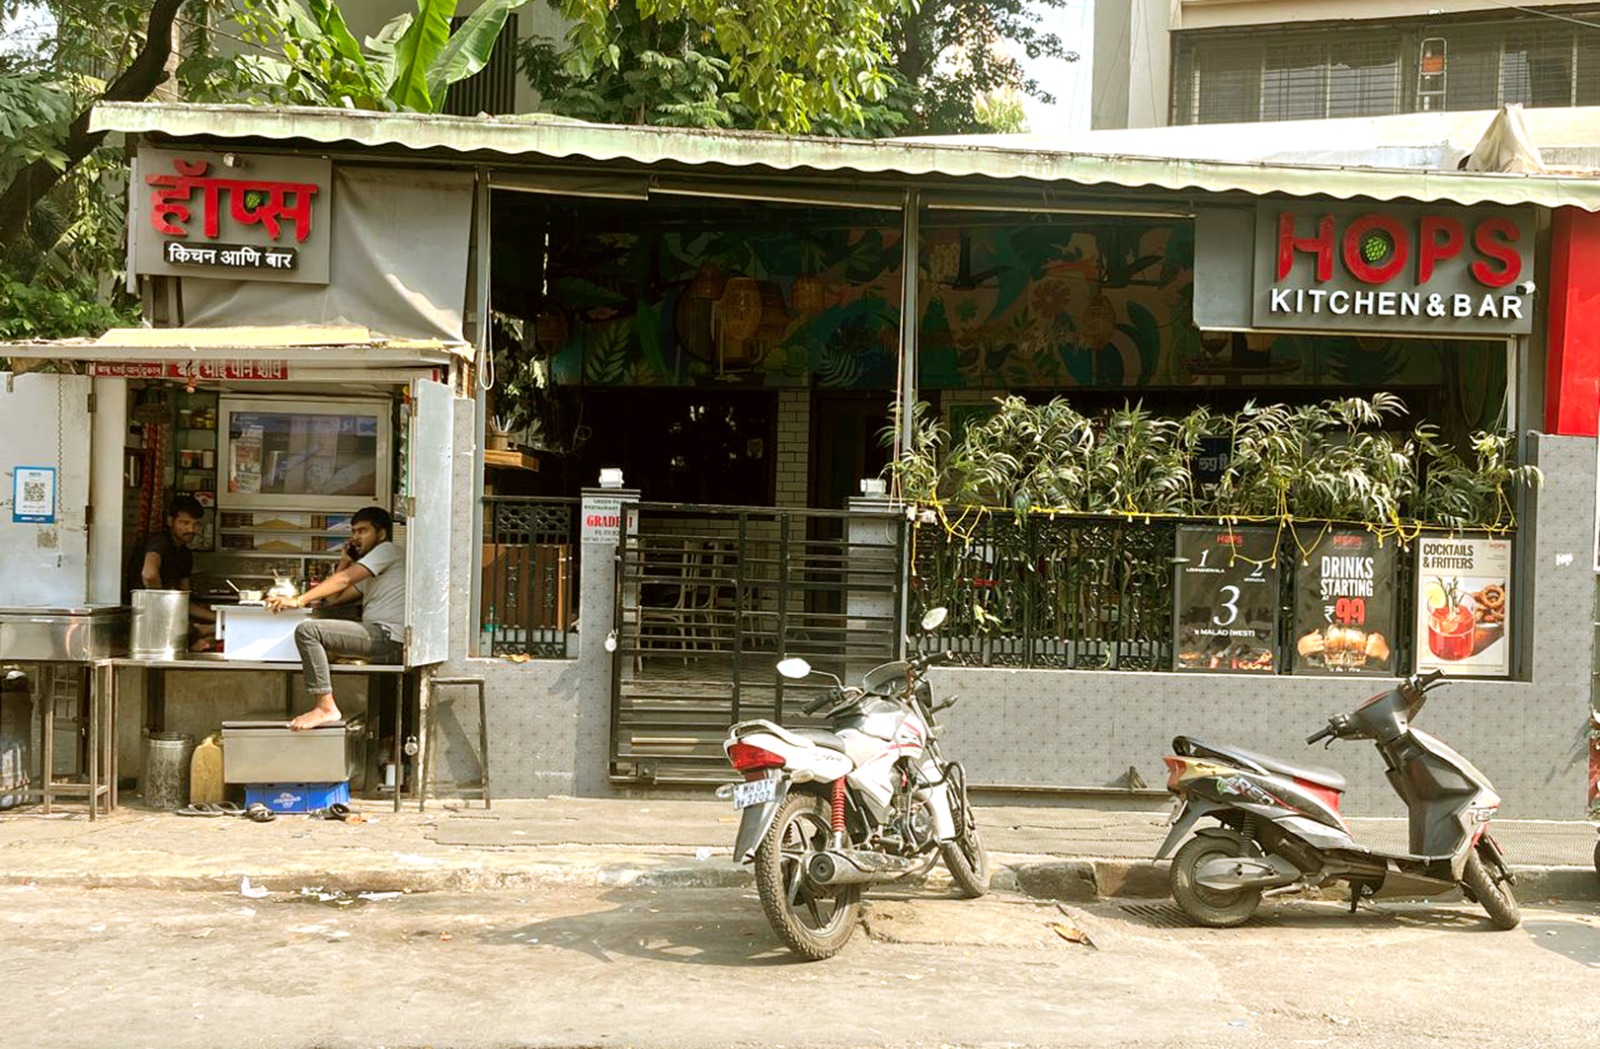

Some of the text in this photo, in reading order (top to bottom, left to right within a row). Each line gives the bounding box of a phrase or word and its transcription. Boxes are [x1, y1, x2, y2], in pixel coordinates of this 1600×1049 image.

[145, 159, 318, 242] हॉप्स
[168, 243, 294, 268] किचन आणि बार
[1277, 211, 1523, 287] HOPS
[1199, 549, 1209, 567] 1
[1423, 543, 1474, 556] COCKTAILS
[1250, 561, 1263, 577] 2
[1321, 556, 1375, 579] DRINKS
[1422, 557, 1474, 569] & FRITTERS
[1320, 578, 1374, 597] STARTING
[1213, 585, 1240, 626] 3
[1200, 628, 1229, 636] MALAD
[1229, 629, 1256, 638] (WEST)
